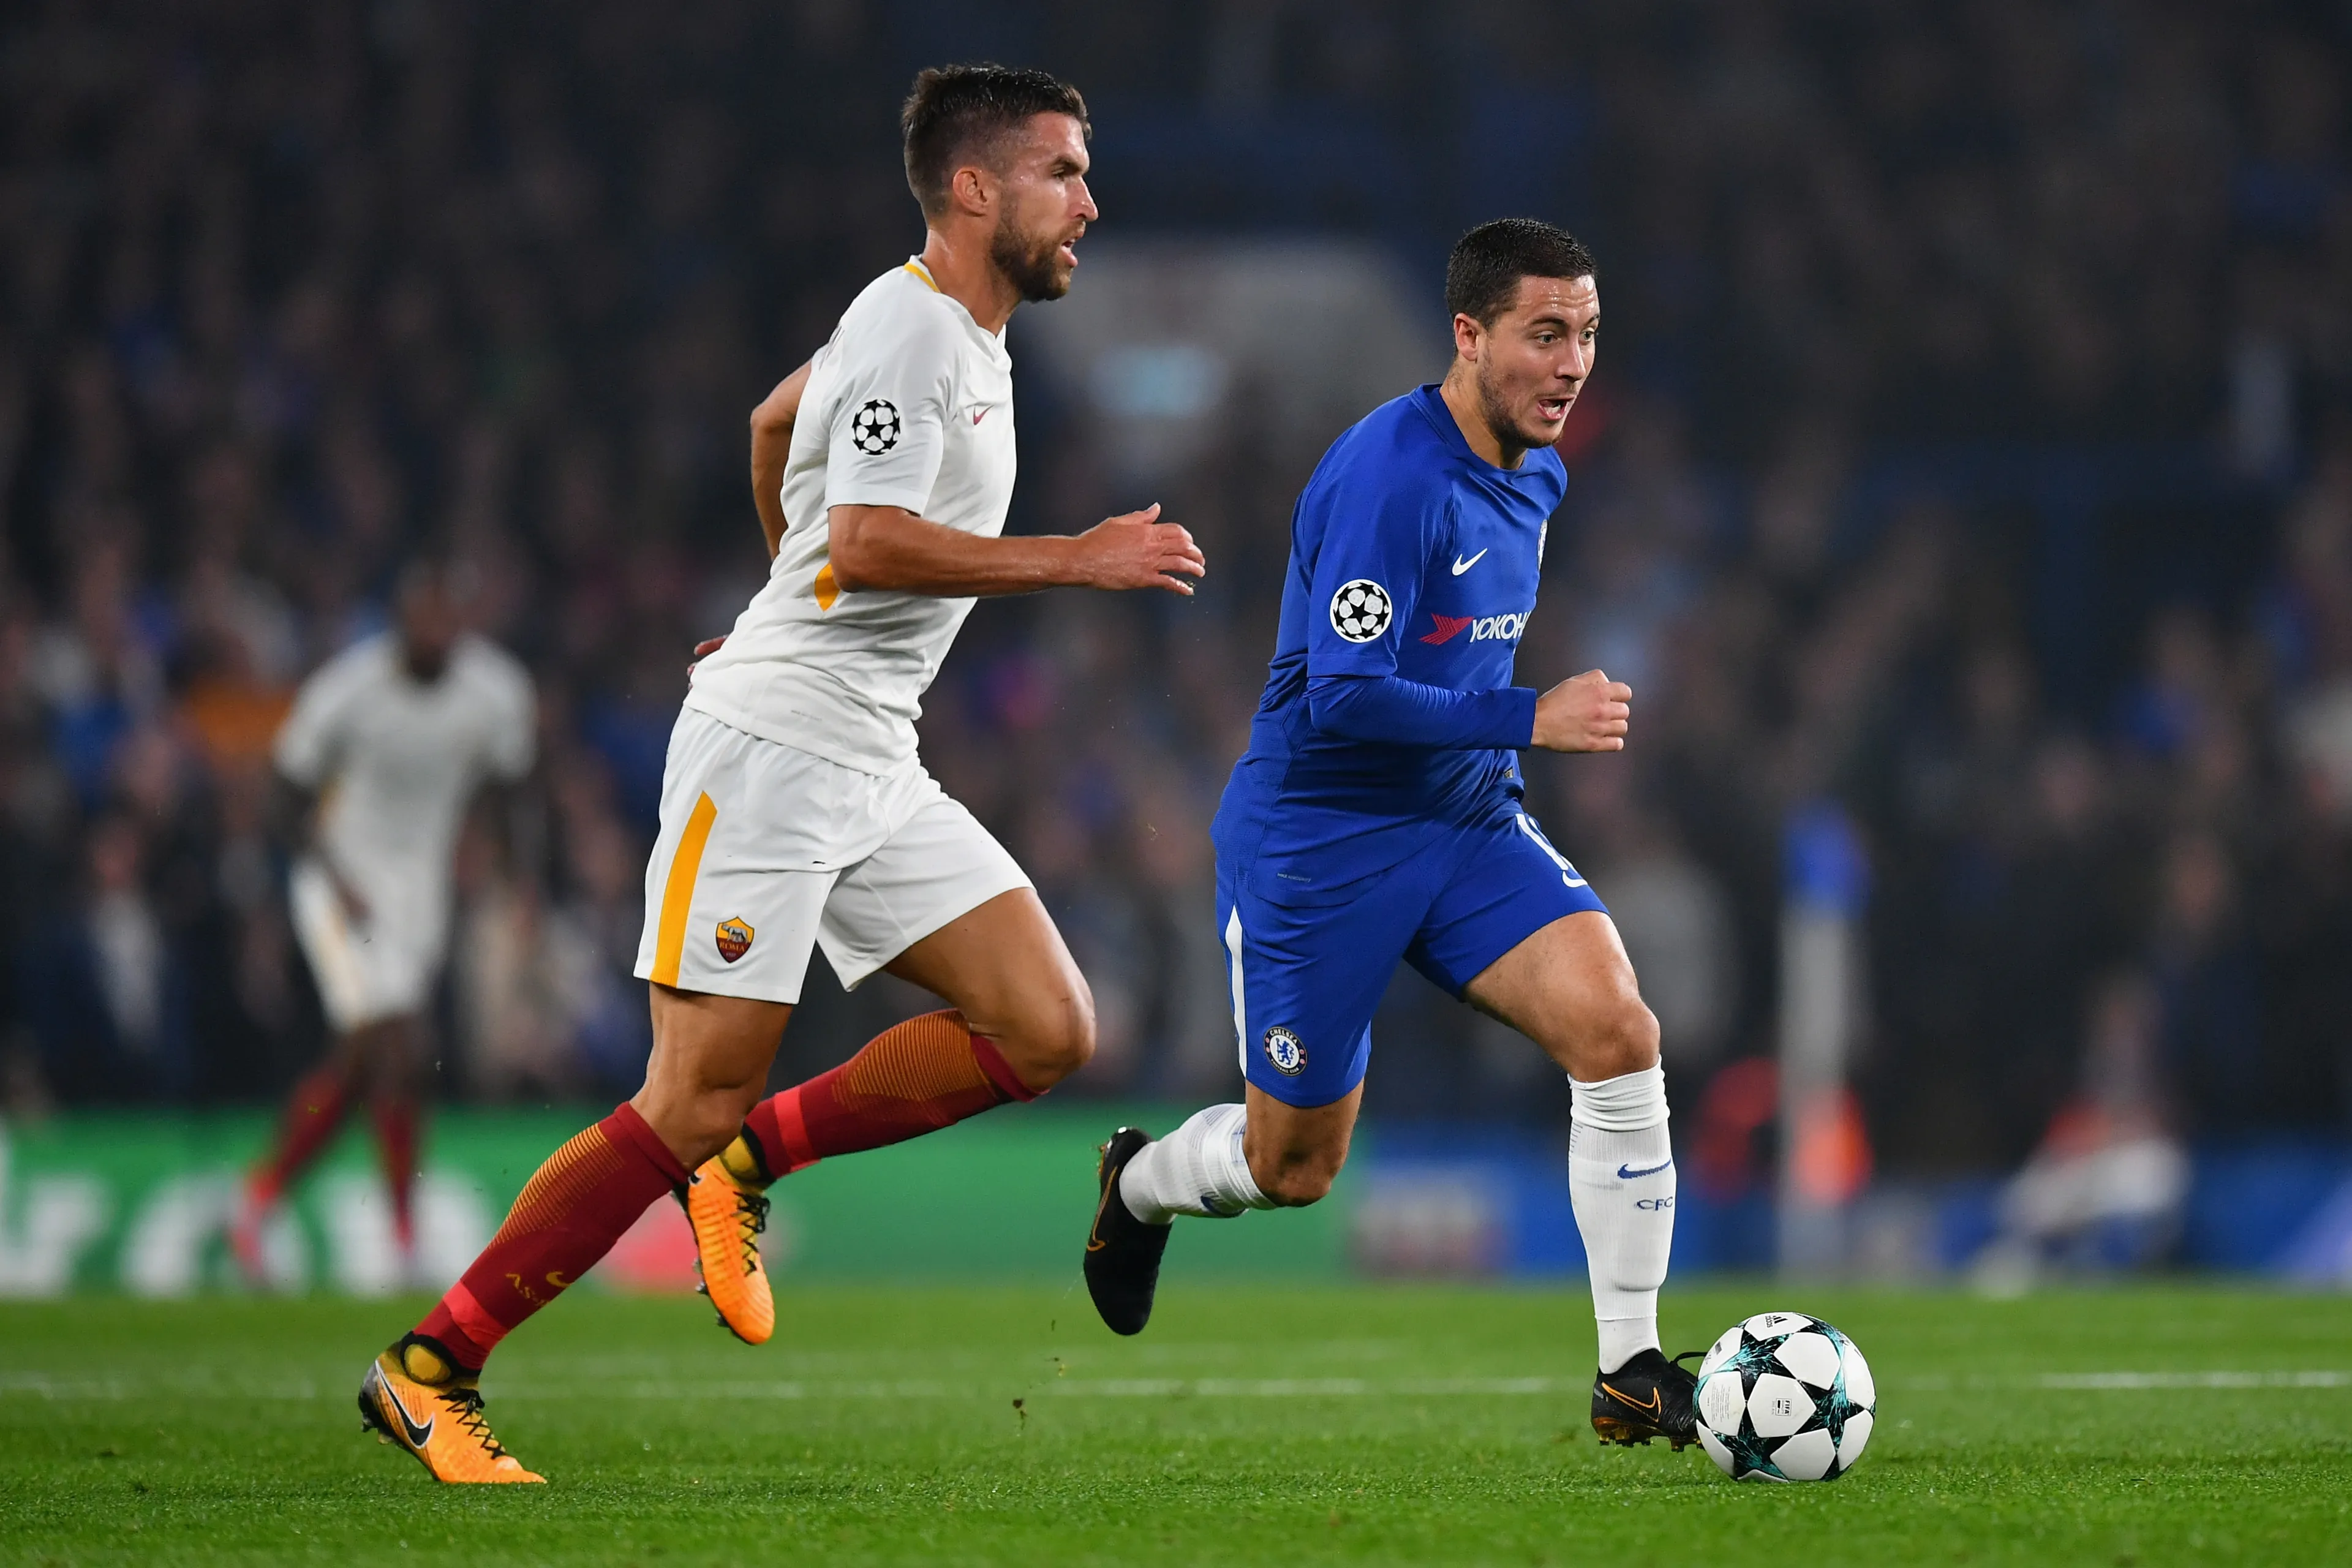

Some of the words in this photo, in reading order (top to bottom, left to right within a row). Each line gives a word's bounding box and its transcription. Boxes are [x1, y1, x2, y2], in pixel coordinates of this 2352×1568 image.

[1469, 610, 1531, 643] YOKOH
[720, 941, 745, 952] ROMA
[1270, 1028, 1298, 1044] CHELSEA
[1636, 1196, 1673, 1211] CFC
